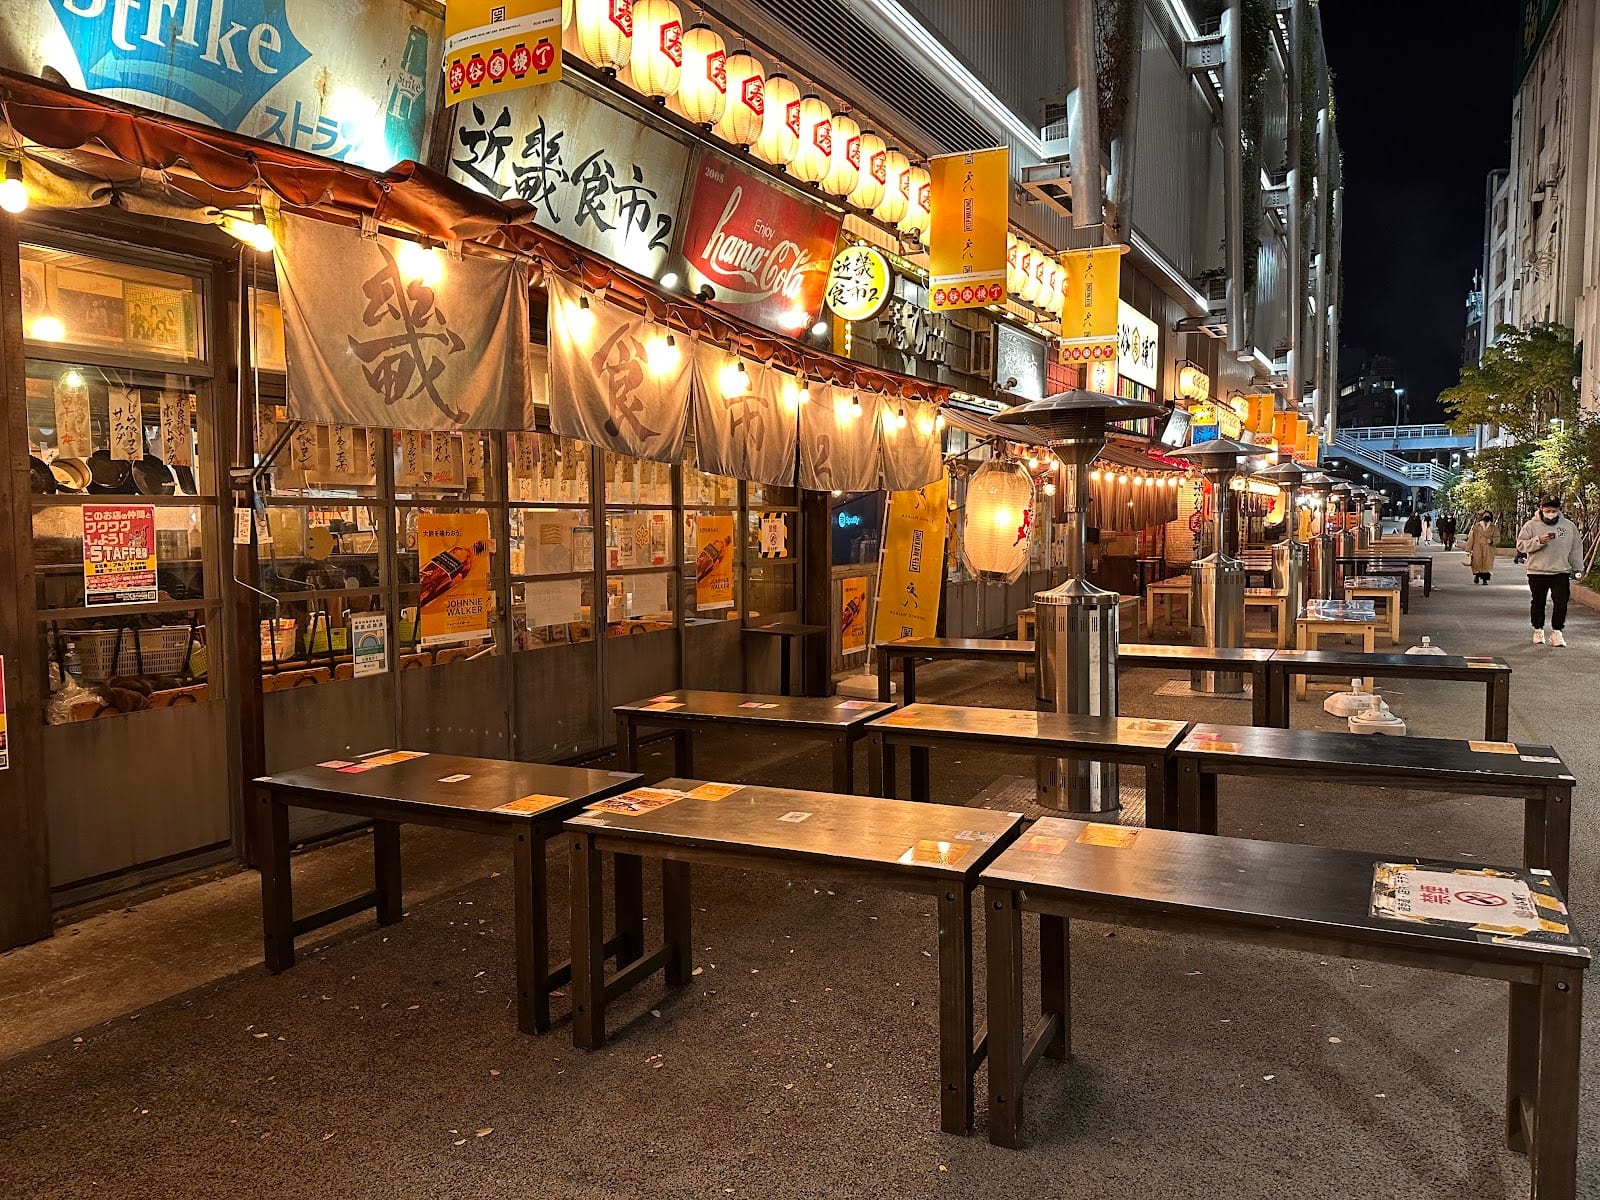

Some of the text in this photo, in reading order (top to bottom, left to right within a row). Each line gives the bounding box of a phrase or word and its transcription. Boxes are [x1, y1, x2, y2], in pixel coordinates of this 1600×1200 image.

[397, 72, 421, 94] Strike
[704, 166, 725, 184] 2008
[753, 218, 775, 240] Enjoy
[113, 407, 125, 445] サラダ
[86, 521, 130, 533] ワクワク
[446, 598, 483, 608] JOHNNIE
[446, 606, 483, 616] WALKER
[1420, 884, 1451, 905] 禁煙
